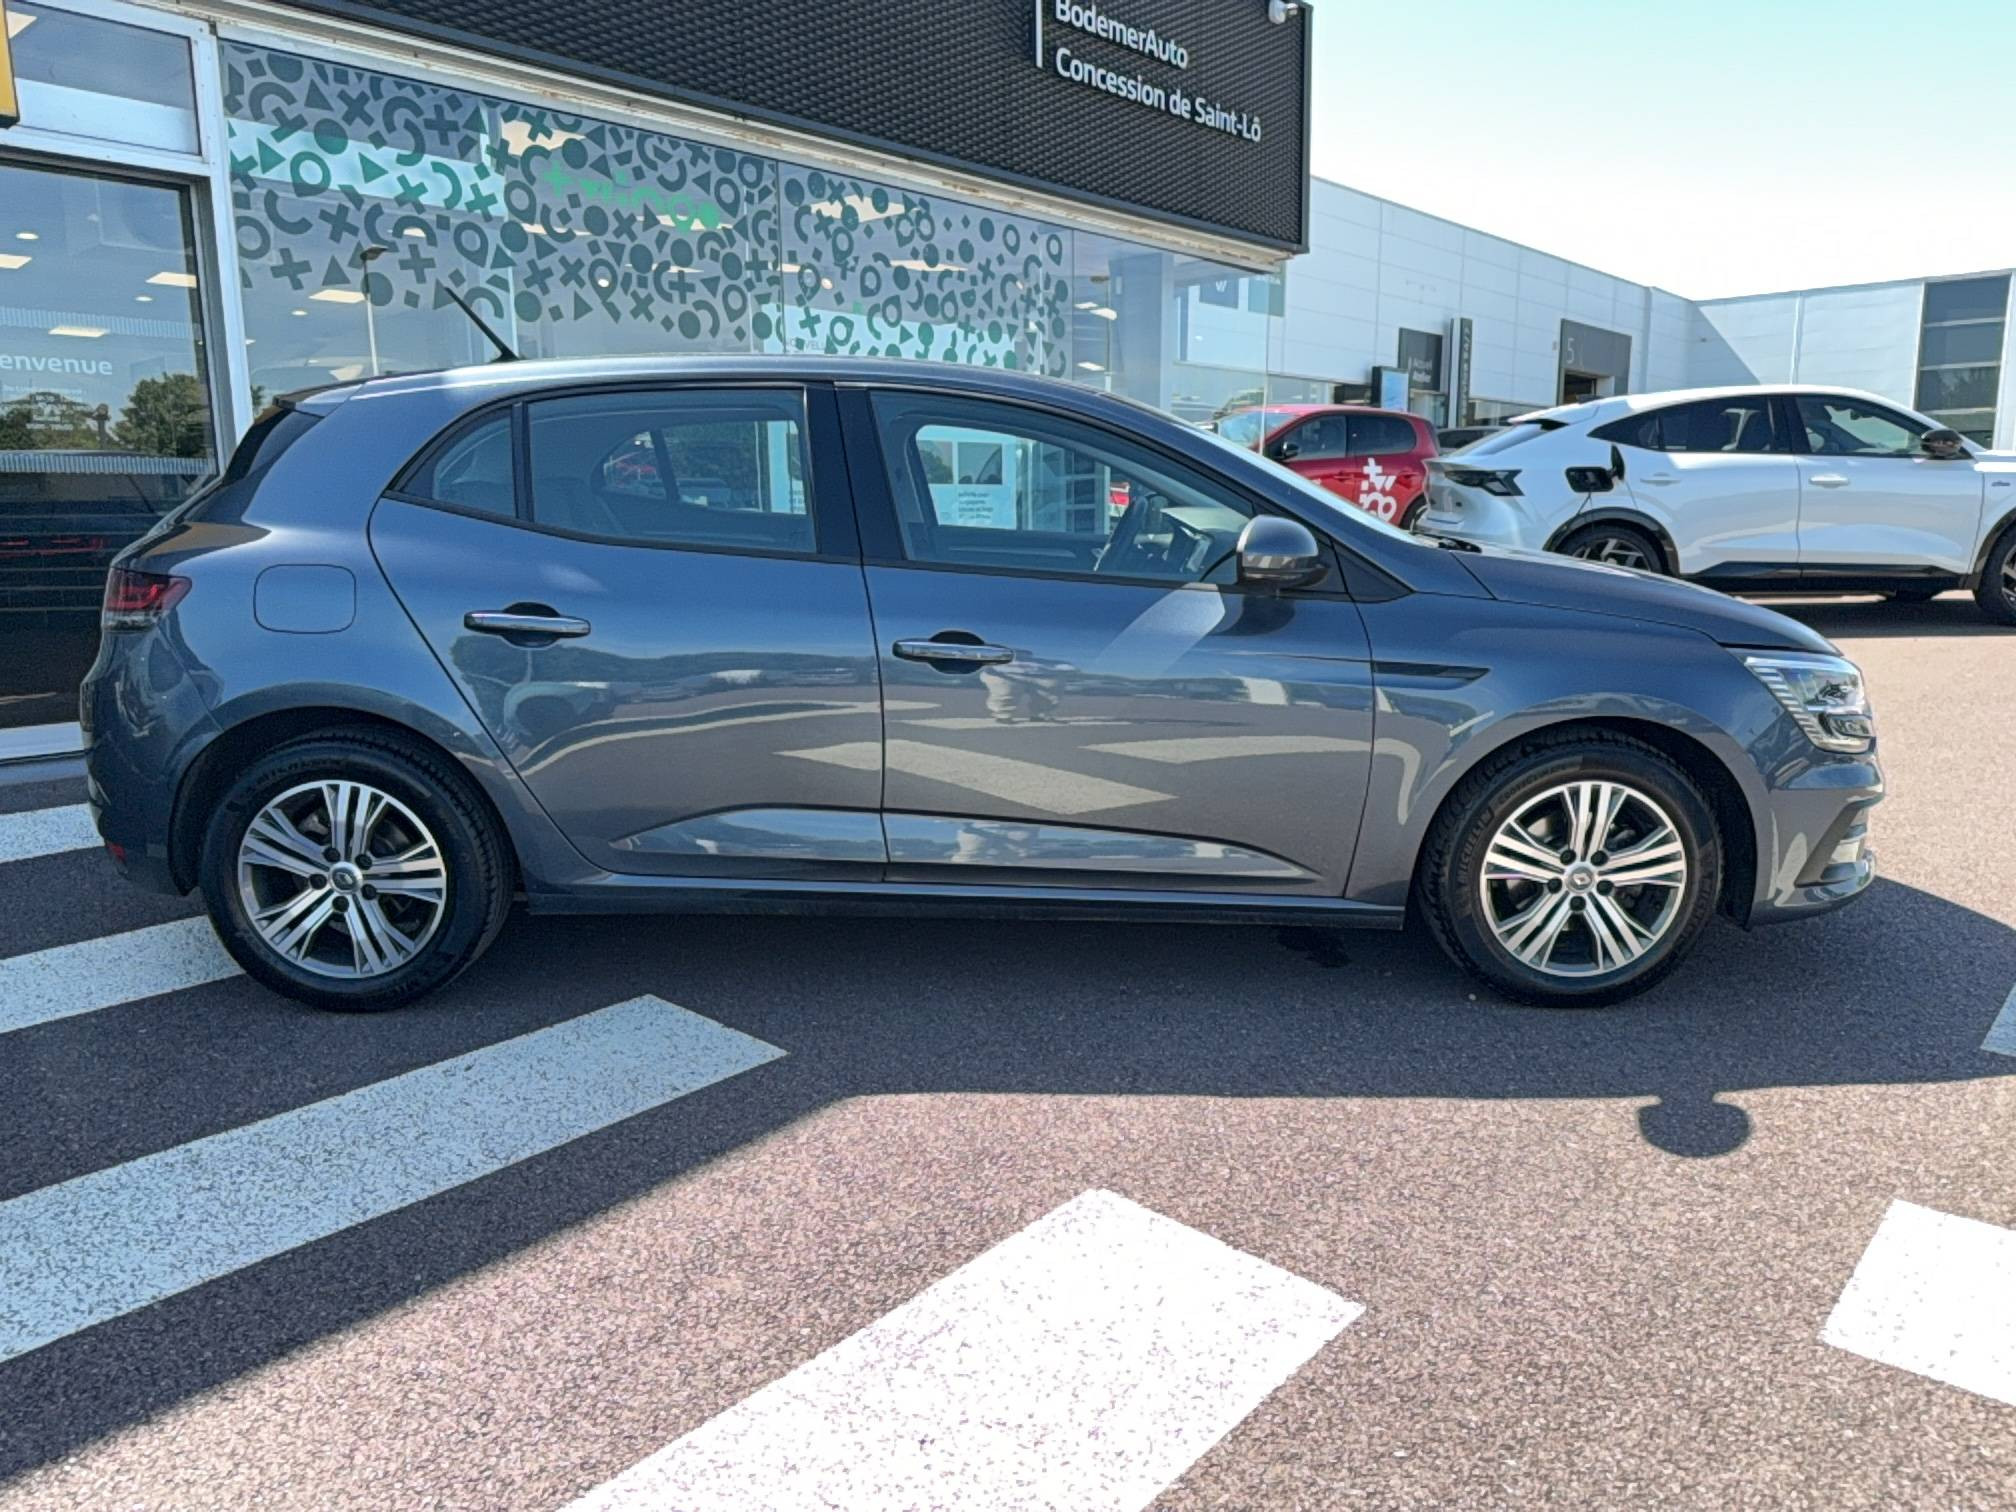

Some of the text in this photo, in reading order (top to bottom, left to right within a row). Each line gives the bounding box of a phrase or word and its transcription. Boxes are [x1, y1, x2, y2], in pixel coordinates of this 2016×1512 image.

[1056, 0, 1188, 69] BodemerAuto
[1055, 47, 1261, 142] Concession de Saint-Lô
